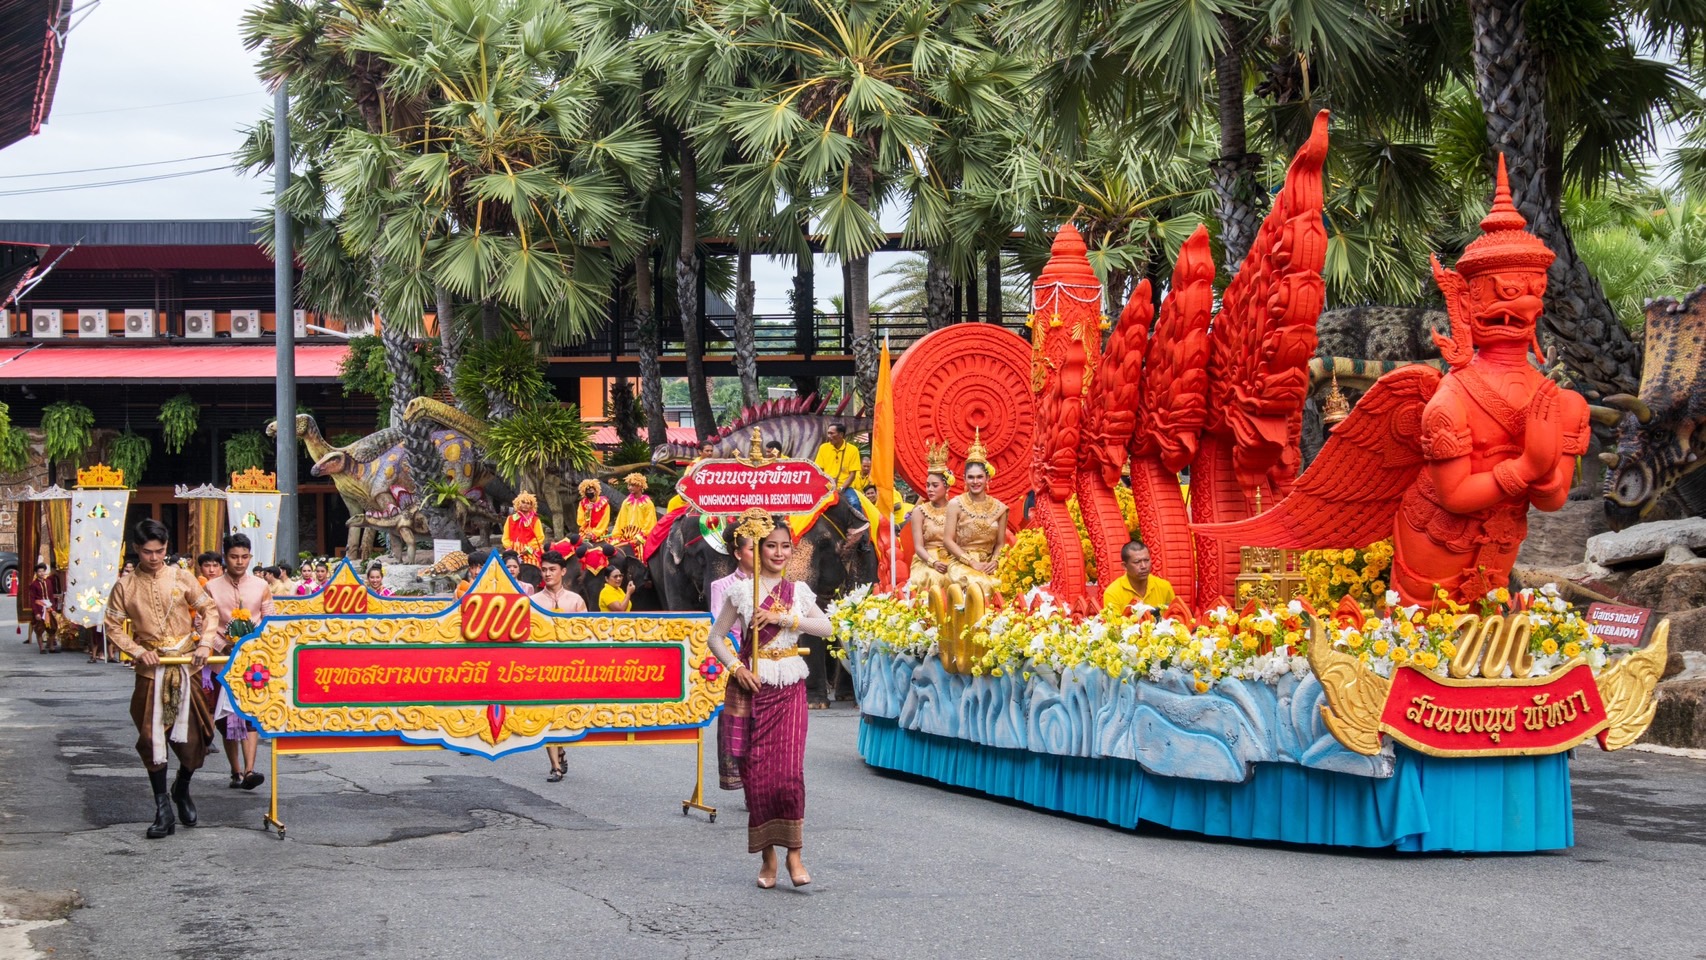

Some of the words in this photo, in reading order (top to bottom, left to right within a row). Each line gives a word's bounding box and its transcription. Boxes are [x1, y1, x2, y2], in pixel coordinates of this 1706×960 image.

[695, 466, 811, 490] สวนนงนุชพัทยา
[699, 494, 739, 506] NONGNOOCH
[740, 494, 763, 505] GARDEN
[765, 494, 769, 504] &
[770, 494, 791, 504] RESORT
[792, 493, 813, 504] PATTAYA
[314, 660, 491, 693] พุทธสยามงามวิถี
[498, 659, 666, 683] ประเพณีแห่เทียน
[1406, 695, 1519, 743] สวนนงนุช
[1523, 689, 1590, 731] พัทยา
